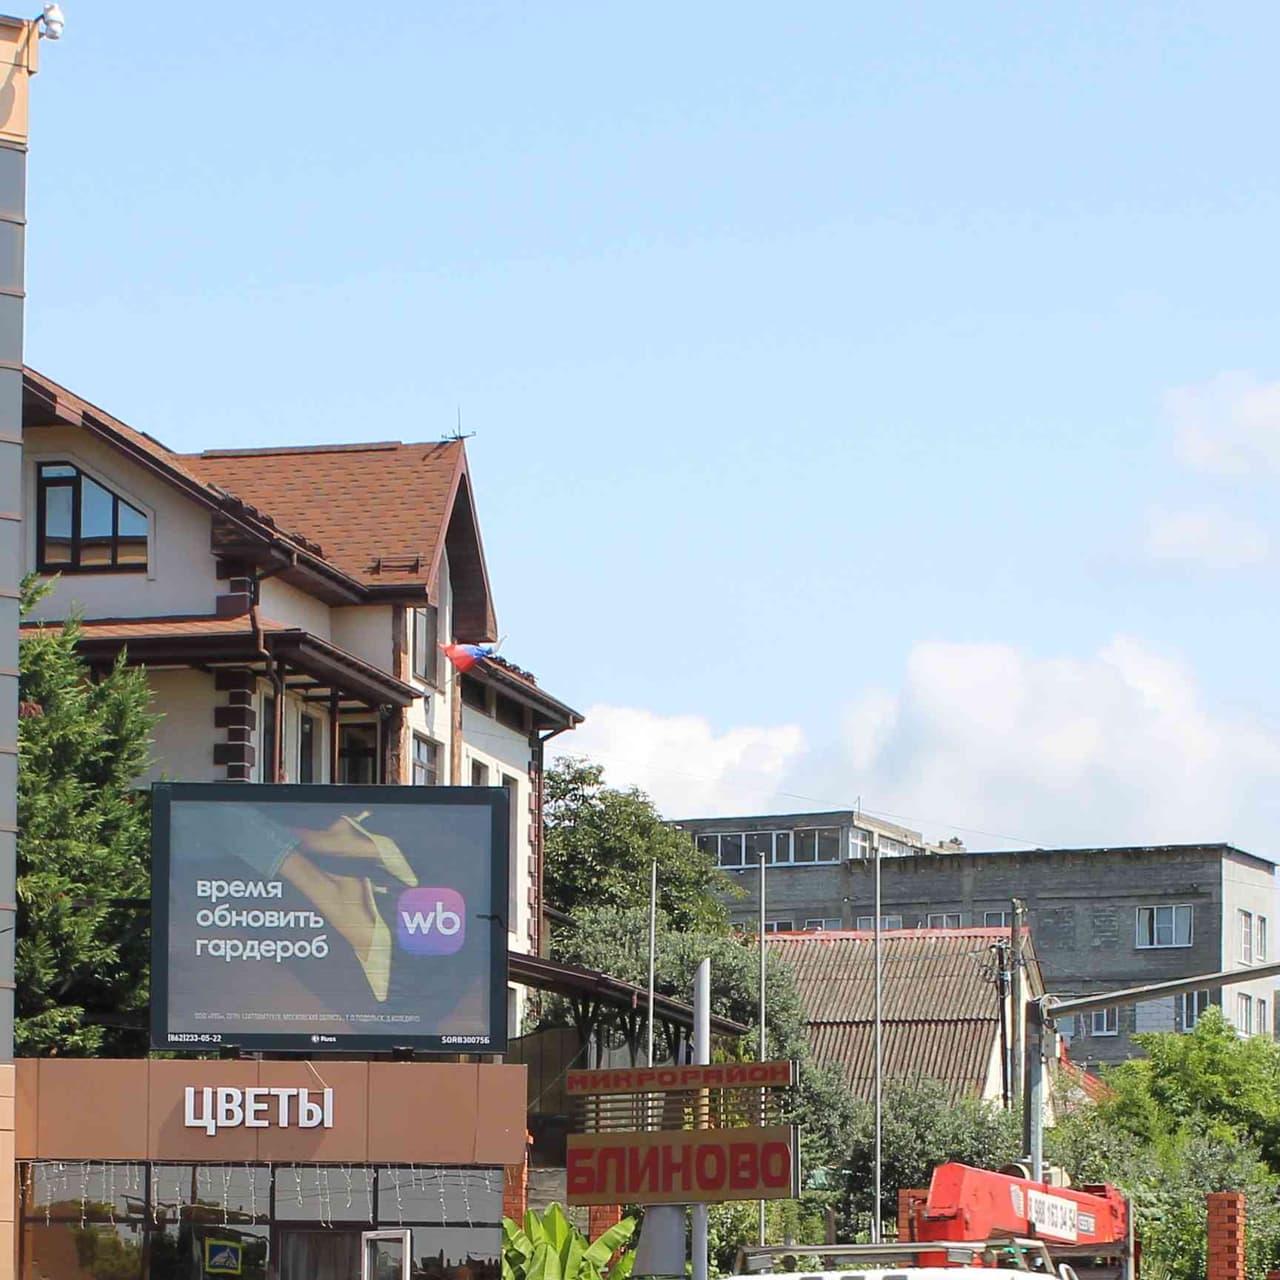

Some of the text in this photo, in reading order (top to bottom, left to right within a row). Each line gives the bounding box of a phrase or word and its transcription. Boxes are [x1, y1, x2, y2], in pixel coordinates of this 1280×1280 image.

[196, 880, 282, 901] время
[196, 904, 324, 928] обновить
[402, 902, 461, 936] wb
[196, 935, 328, 962] гардероб
[567, 1063, 789, 1091] МИКРОРАЙОН
[184, 1086, 334, 1136] ЦВЕТЫ
[567, 1142, 791, 1195] БЛИНОВО
